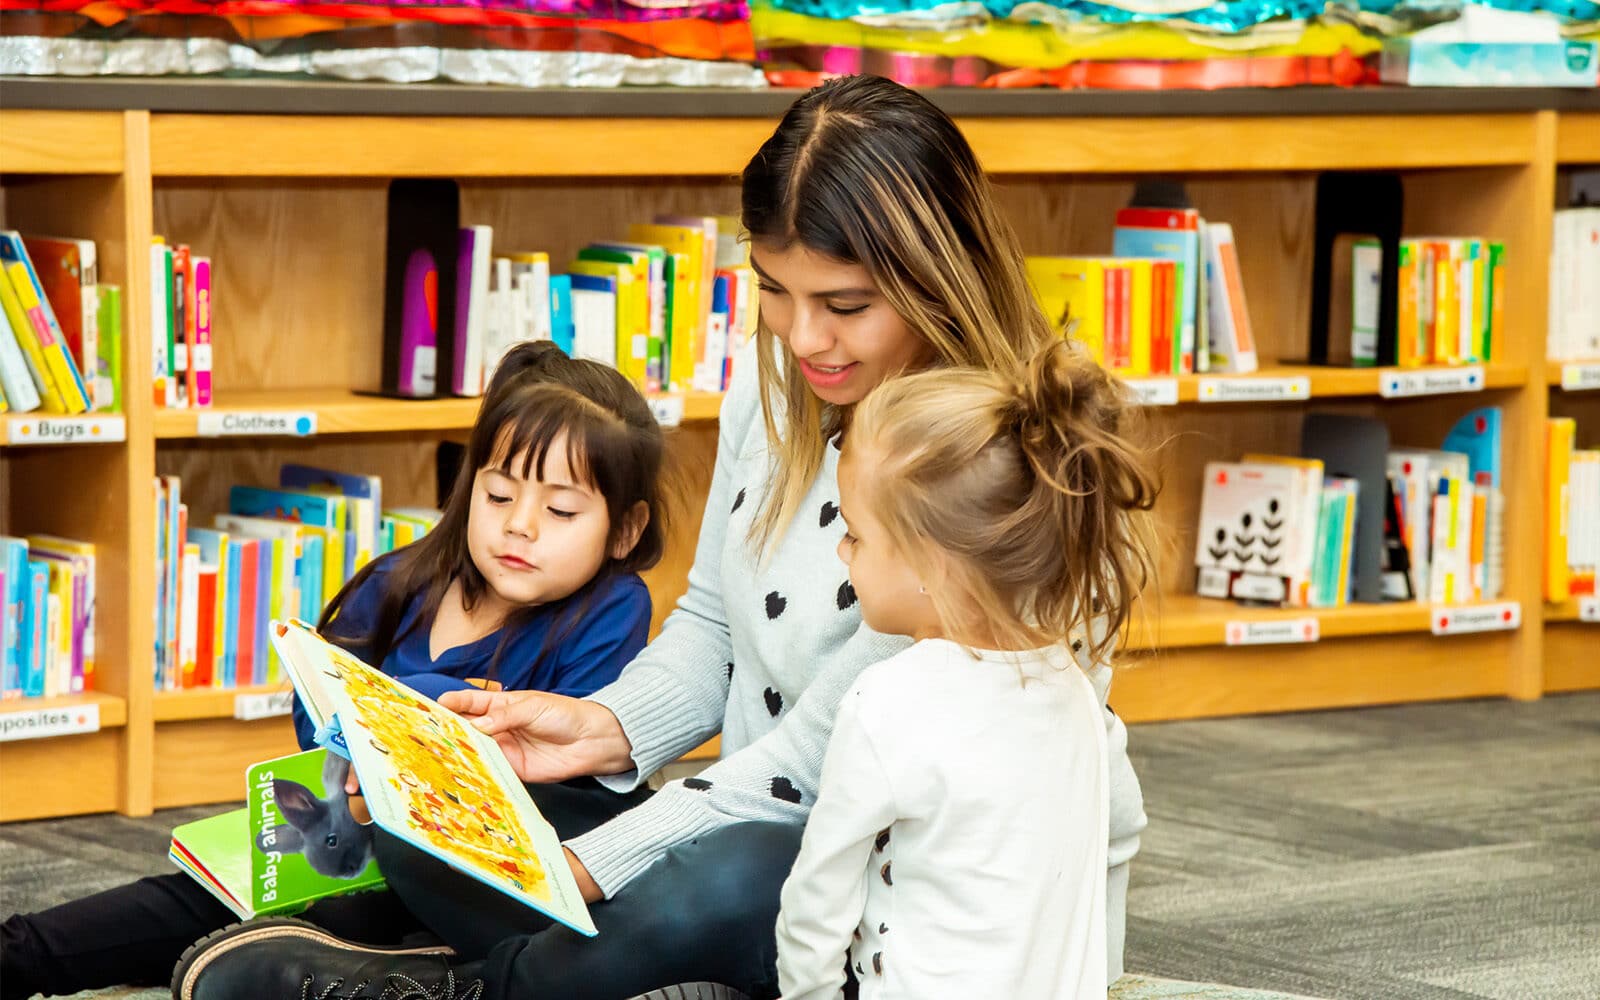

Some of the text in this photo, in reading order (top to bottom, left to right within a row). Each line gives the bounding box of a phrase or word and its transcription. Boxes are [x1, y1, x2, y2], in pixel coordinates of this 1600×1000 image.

[39, 421, 84, 440] Bugs
[222, 415, 286, 429] Clothes
[256, 770, 283, 902] Baby animals
